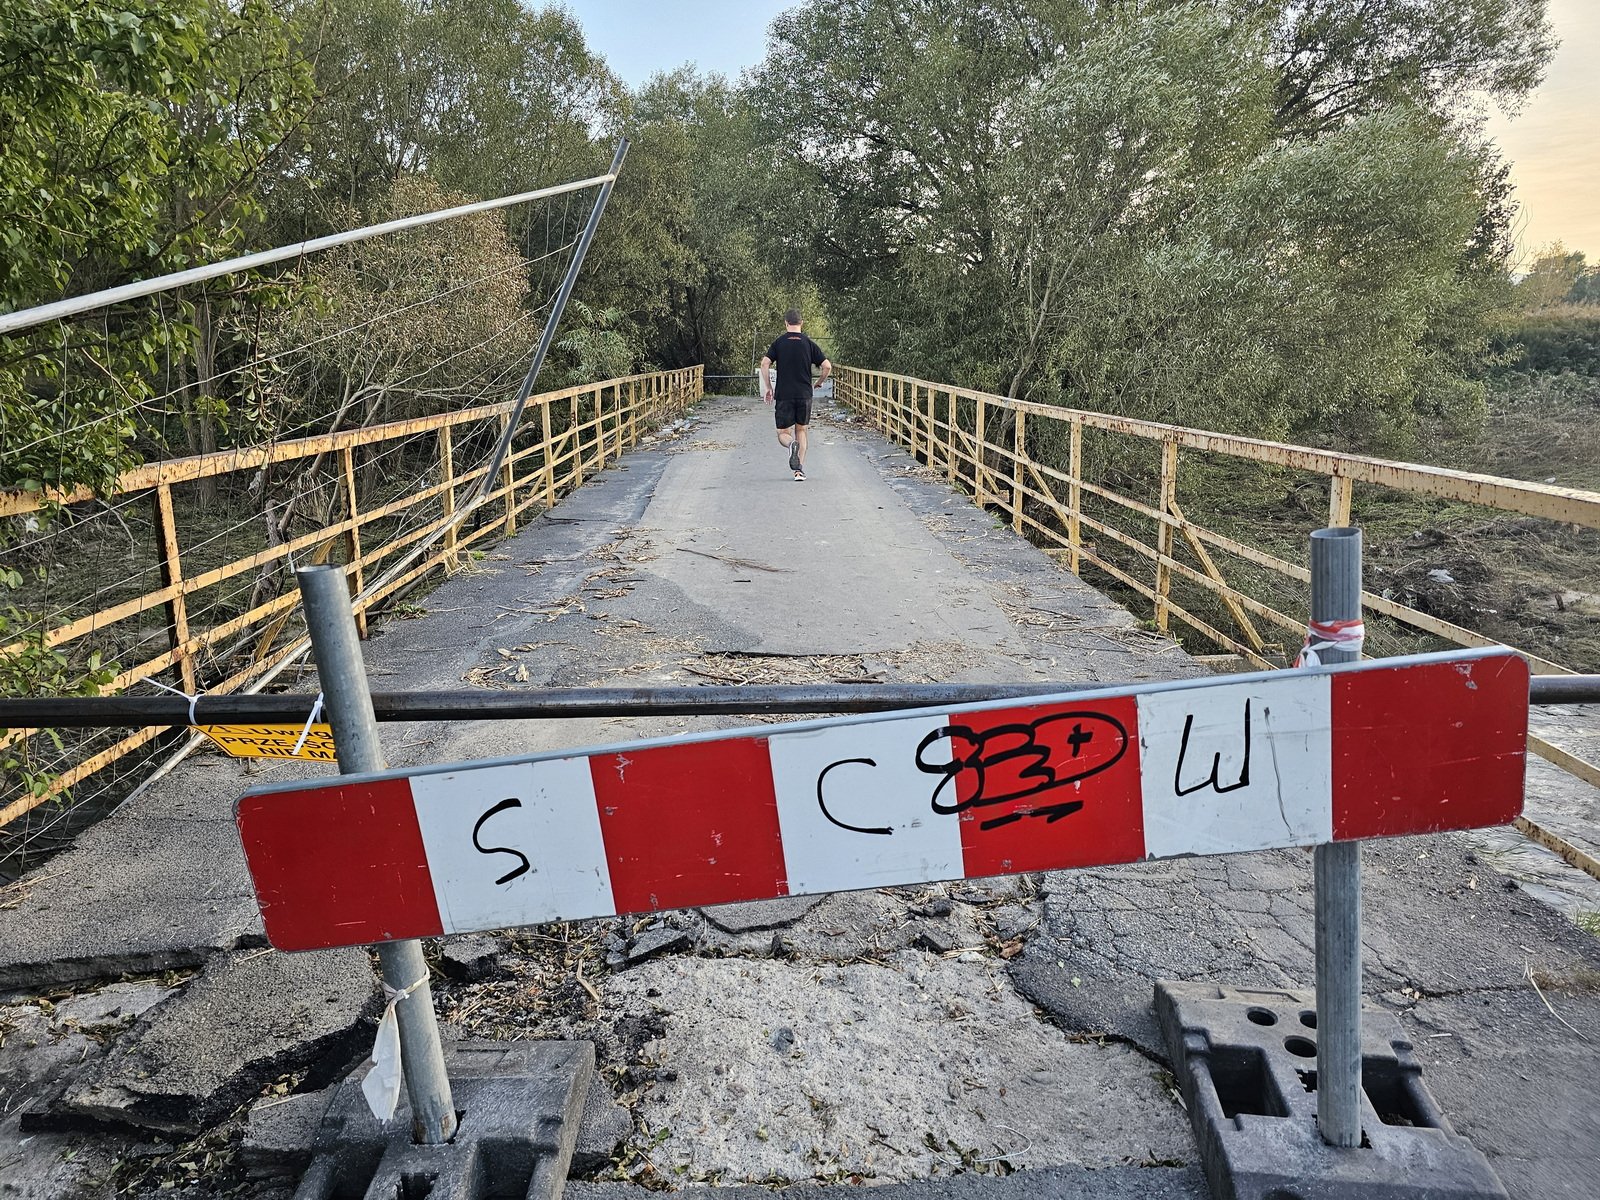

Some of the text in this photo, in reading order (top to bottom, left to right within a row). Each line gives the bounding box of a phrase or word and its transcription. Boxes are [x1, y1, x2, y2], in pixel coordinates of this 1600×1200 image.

[248, 728, 334, 740] Uwag
[258, 747, 338, 759] NIE M
[472, 797, 531, 885] S
[1174, 698, 1251, 796] W
